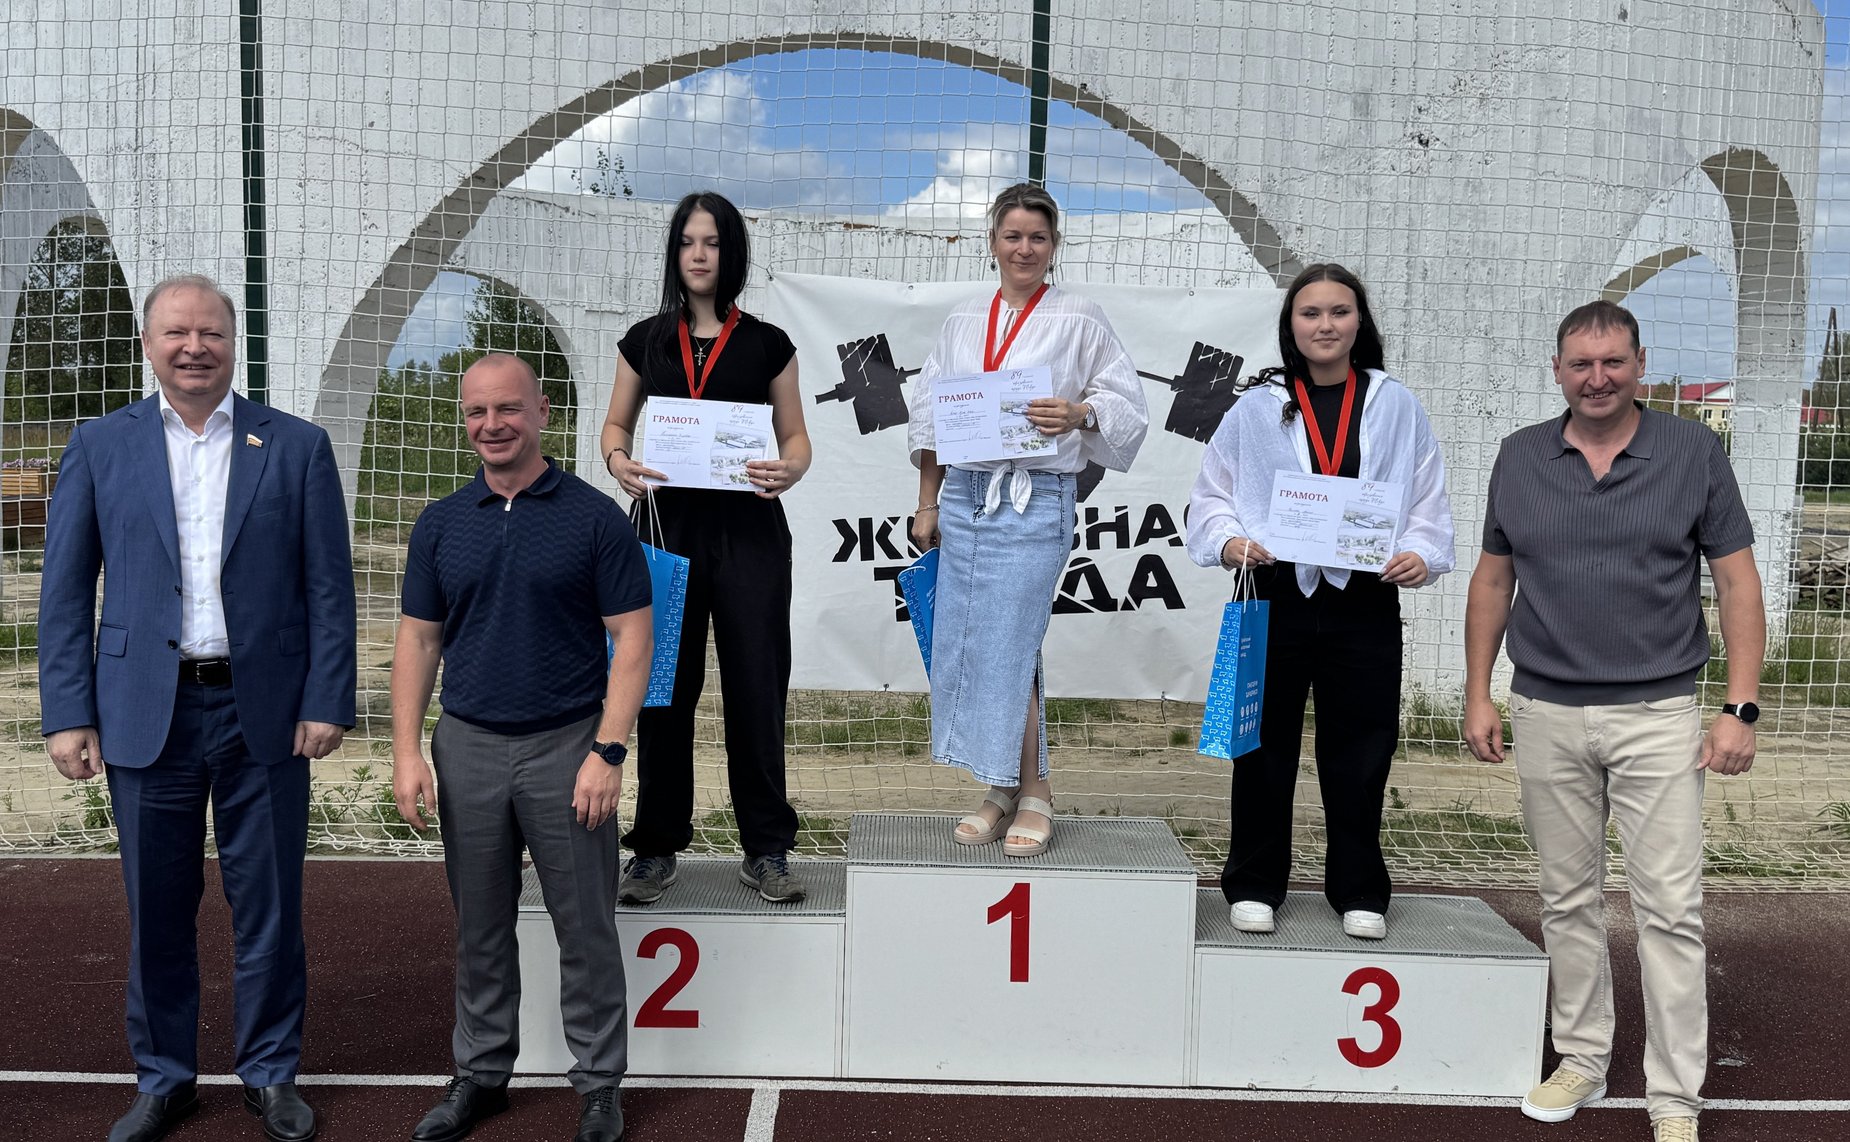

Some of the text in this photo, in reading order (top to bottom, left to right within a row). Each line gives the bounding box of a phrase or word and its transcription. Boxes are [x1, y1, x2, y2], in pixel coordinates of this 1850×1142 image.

[653, 415, 700, 425] ГРАМОТА
[939, 391, 984, 403] ГРАМОТА
[1279, 489, 1329, 502] ГРАМОТА
[988, 883, 1030, 982] 1
[636, 929, 698, 1027] 2
[1338, 968, 1401, 1067] 3
